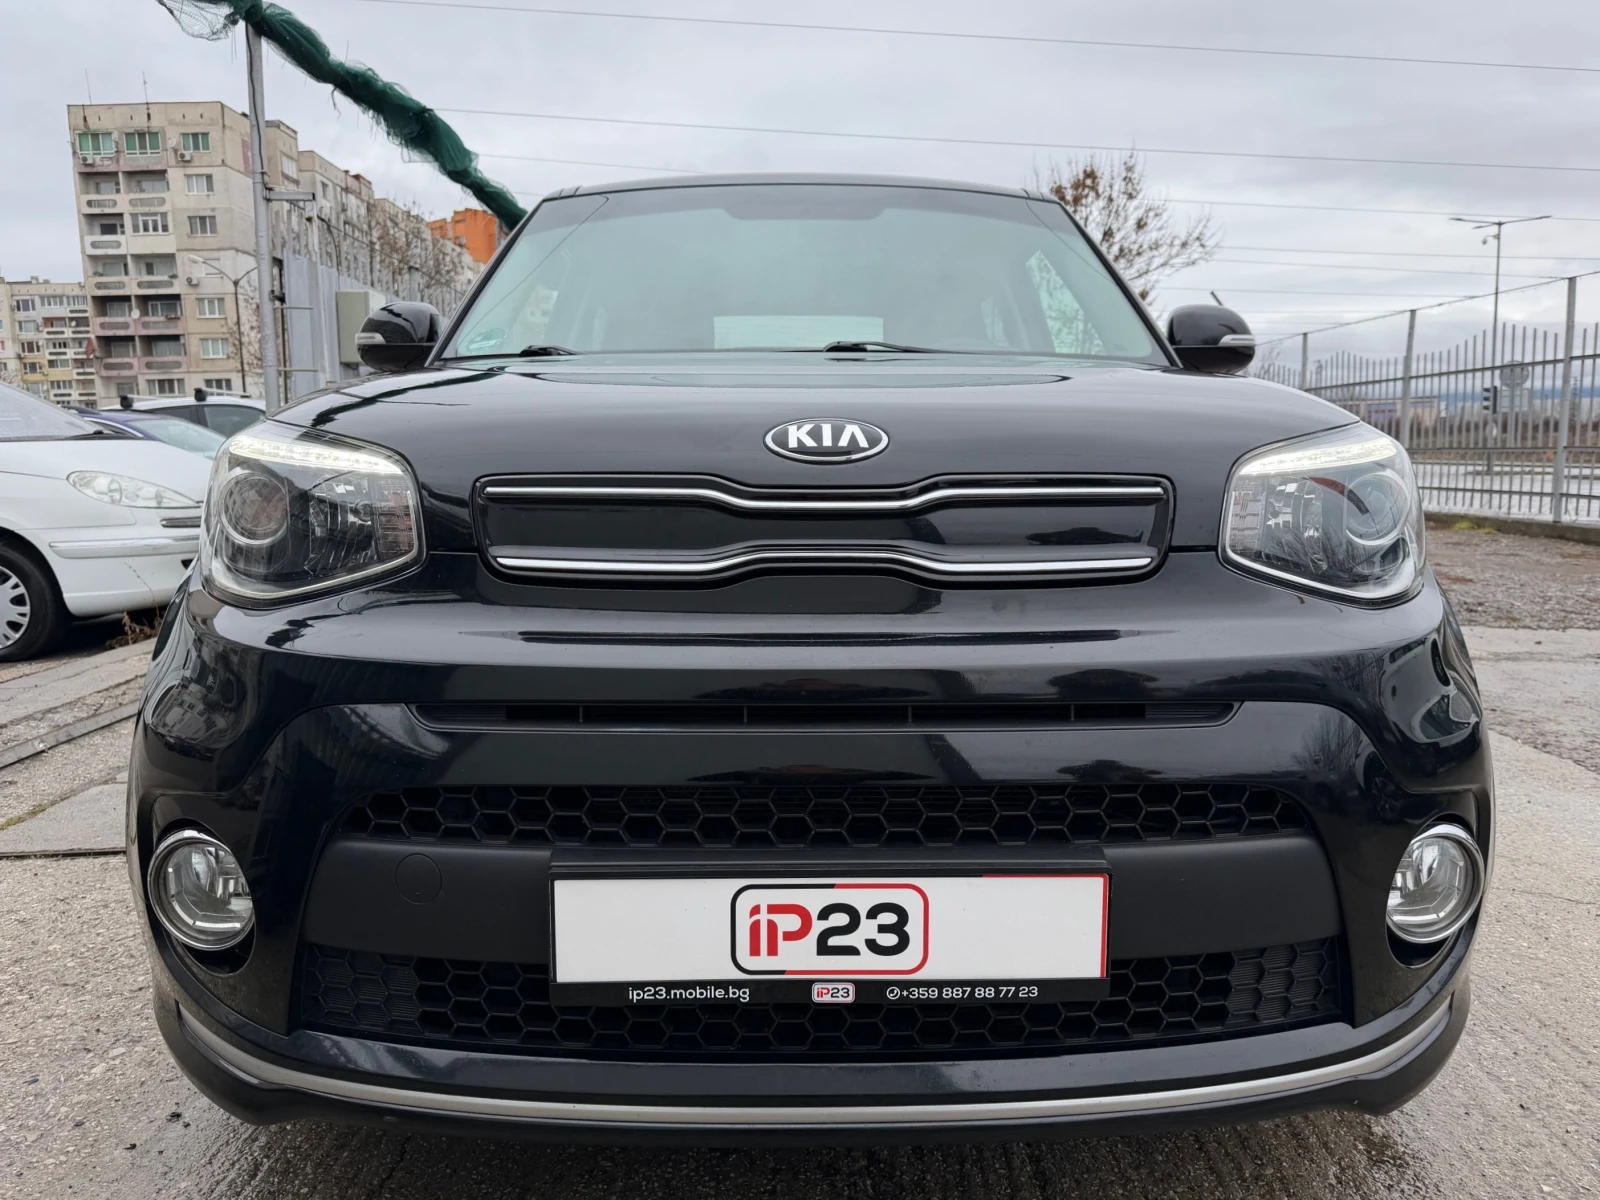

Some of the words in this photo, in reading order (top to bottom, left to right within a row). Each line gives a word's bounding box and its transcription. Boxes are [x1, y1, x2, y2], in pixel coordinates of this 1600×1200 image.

[786, 423, 869, 448] KIA
[749, 902, 910, 957] iP23
[628, 985, 750, 1003] ip23.mobile.bg
[901, 987, 939, 999] +359
[942, 987, 972, 999] 887
[974, 986, 995, 998] 88
[998, 986, 1016, 998] 77
[1018, 985, 1039, 998] 23
